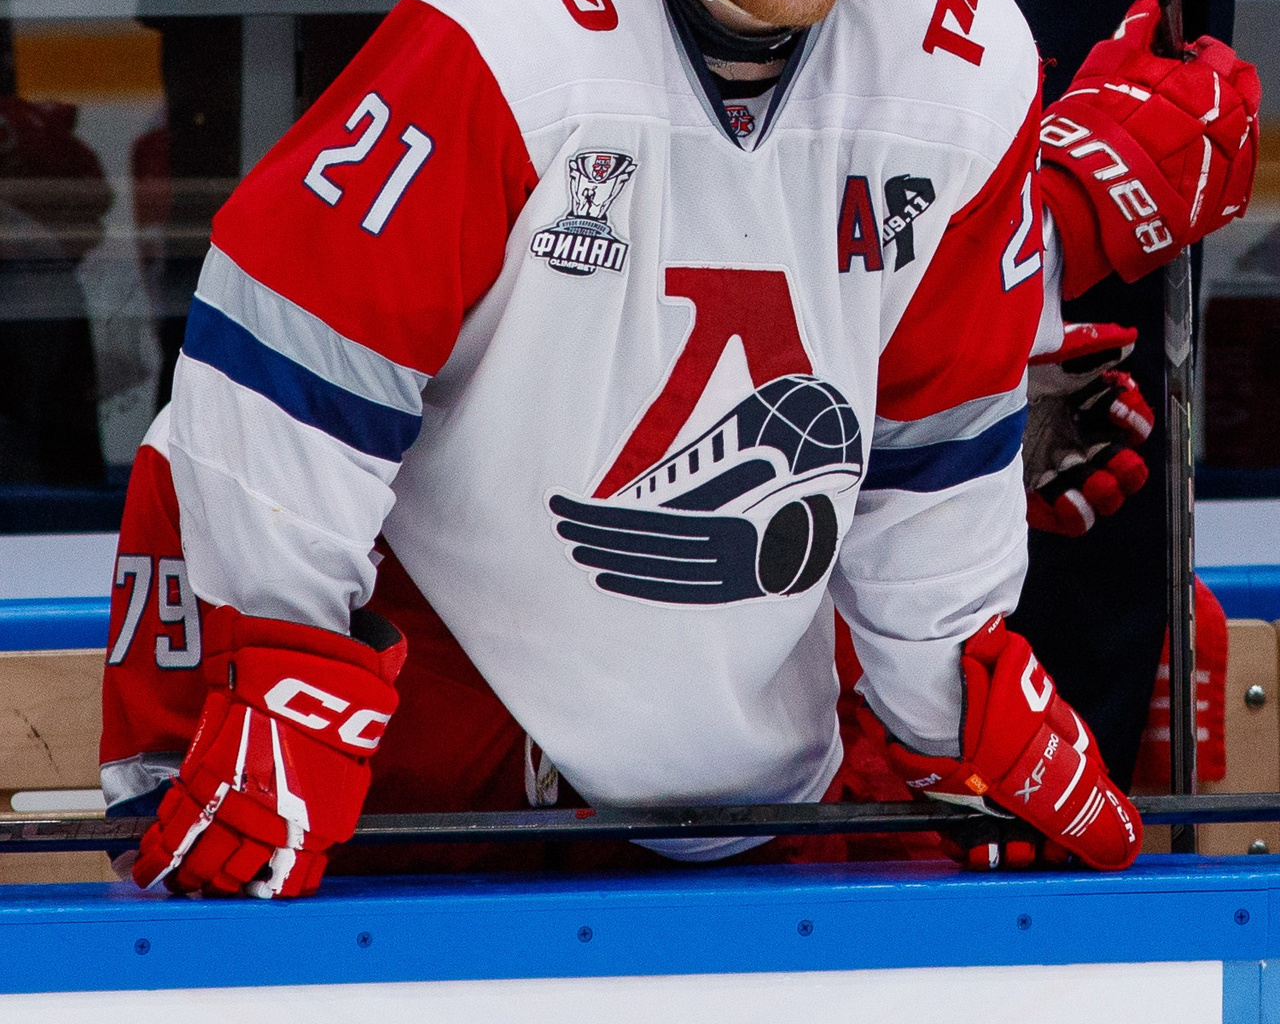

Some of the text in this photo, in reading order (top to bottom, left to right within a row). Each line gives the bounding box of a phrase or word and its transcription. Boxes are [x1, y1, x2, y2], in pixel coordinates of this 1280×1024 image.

[303, 91, 433, 238] 21
[532, 232, 627, 271] ФИНАЛ
[106, 554, 202, 670] 79
[1044, 733, 1059, 760] PRO
[1106, 789, 1136, 843] CCM
